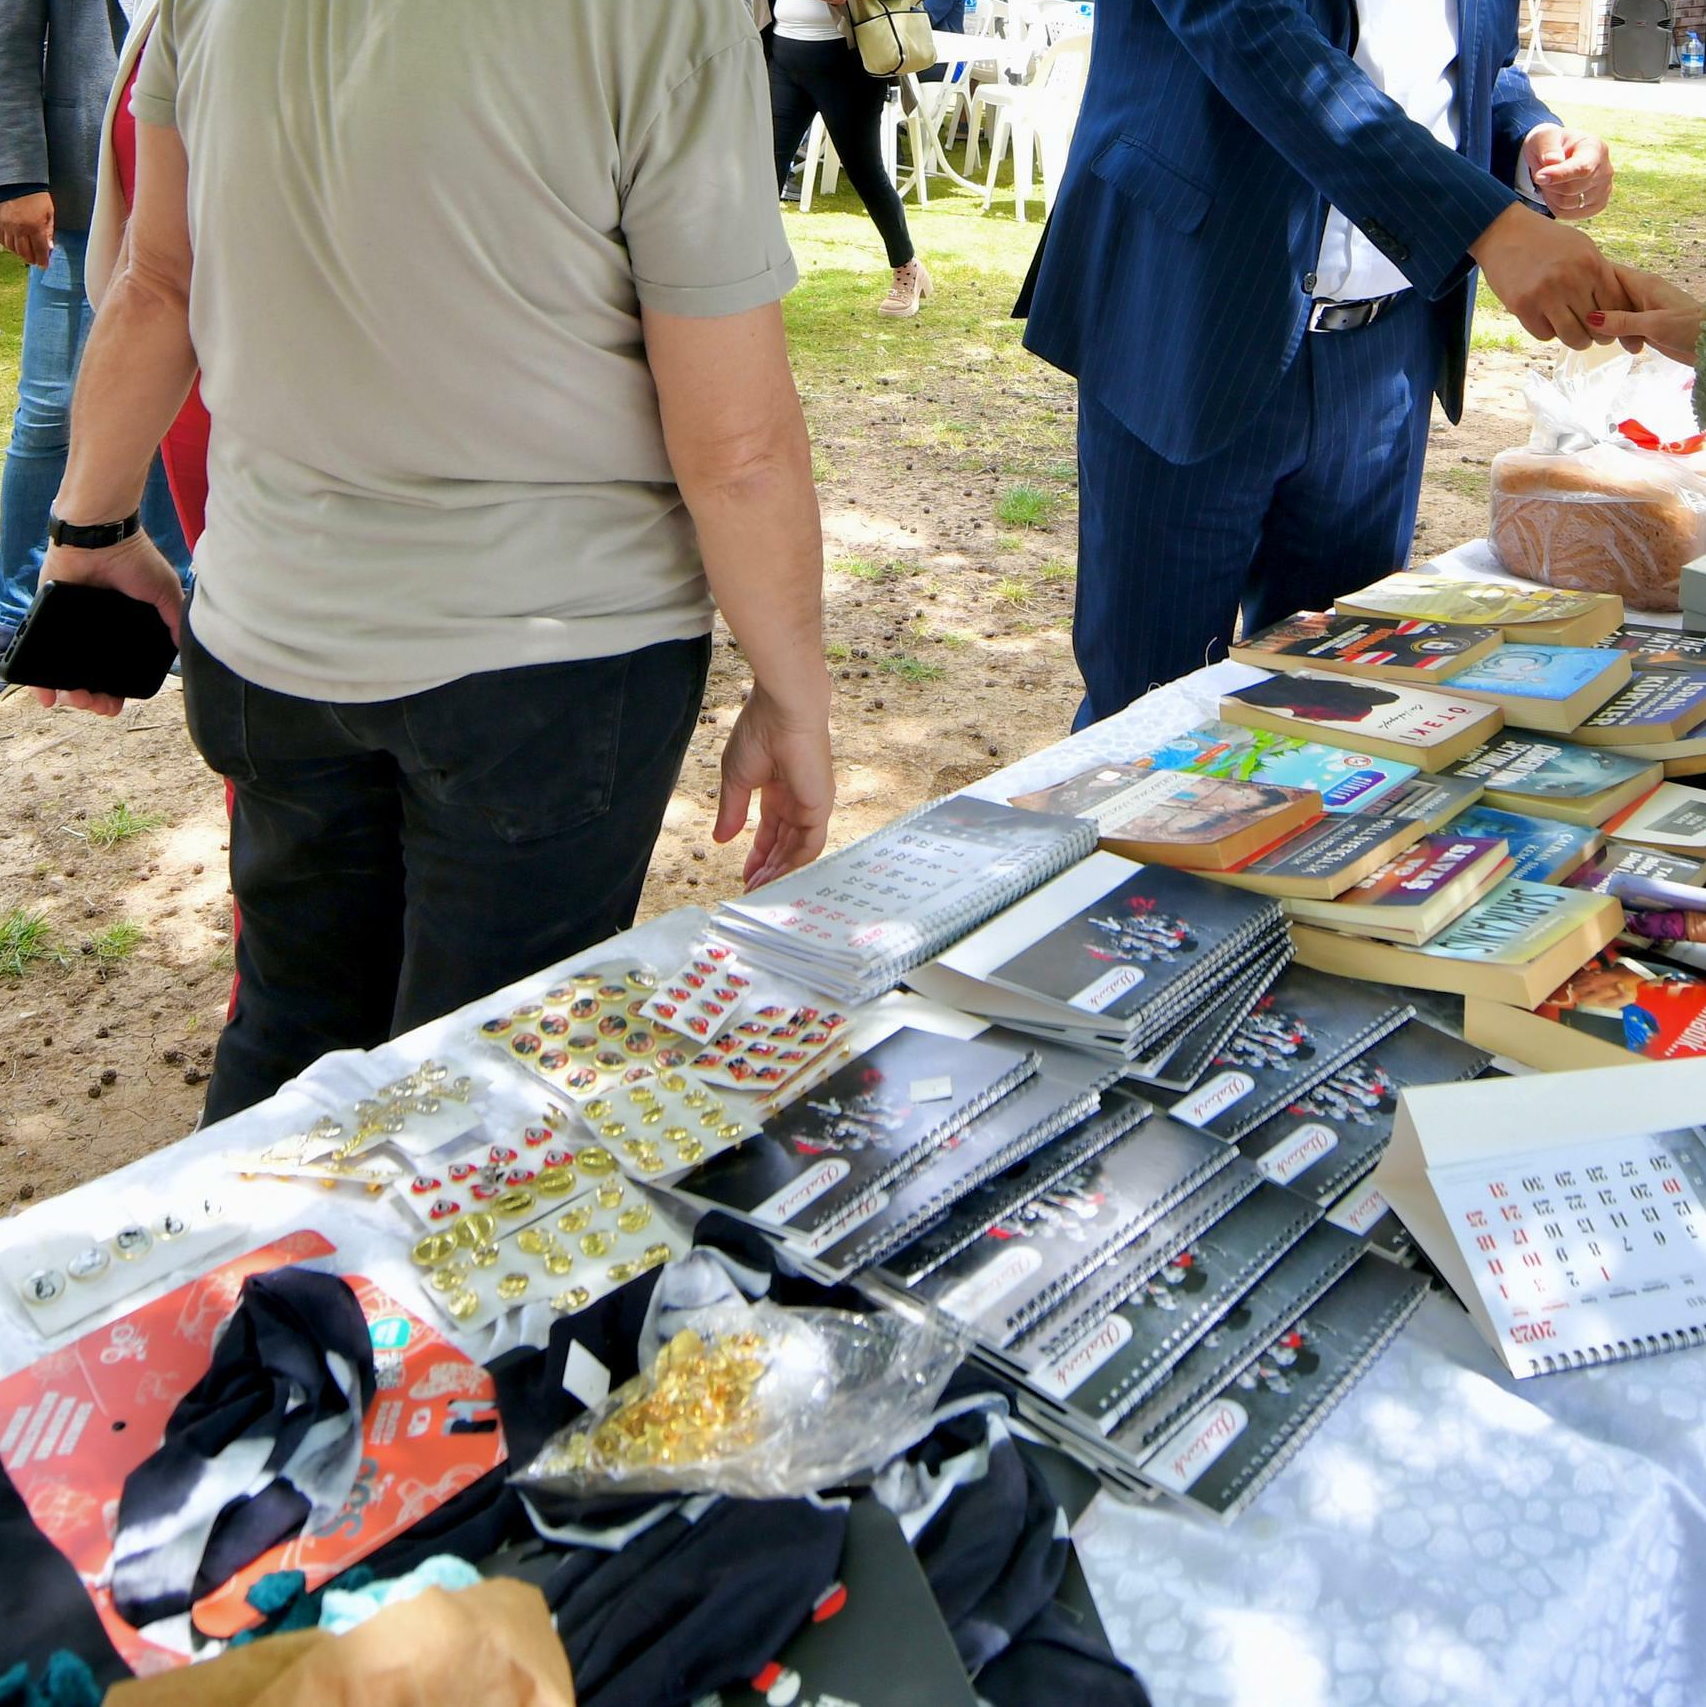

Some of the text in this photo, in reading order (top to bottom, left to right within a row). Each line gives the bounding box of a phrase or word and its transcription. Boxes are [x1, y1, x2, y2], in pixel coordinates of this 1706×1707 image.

[1638, 632, 1681, 655] HATE
[1587, 676, 1670, 726] KÜRTLER
[1400, 844, 1476, 890] SAVAŞ
[1488, 1155, 1672, 1198] 26 27 28 29 30 31
[1466, 1177, 1682, 1227] 19 20 21 22 23 24 25
[1477, 1201, 1691, 1251] 12 13 14 15 16 17 18
[1623, 1236, 1633, 1253] 7
[1654, 1230, 1666, 1245] 6
[1557, 1247, 1569, 1262] 9
[1589, 1241, 1601, 1257] 8
[1487, 1259, 1504, 1275] 11
[1522, 1253, 1541, 1267] 10
[1567, 1271, 1579, 1287] 2
[1601, 1267, 1611, 1281] 1
[1510, 1321, 1556, 1343] 2025
